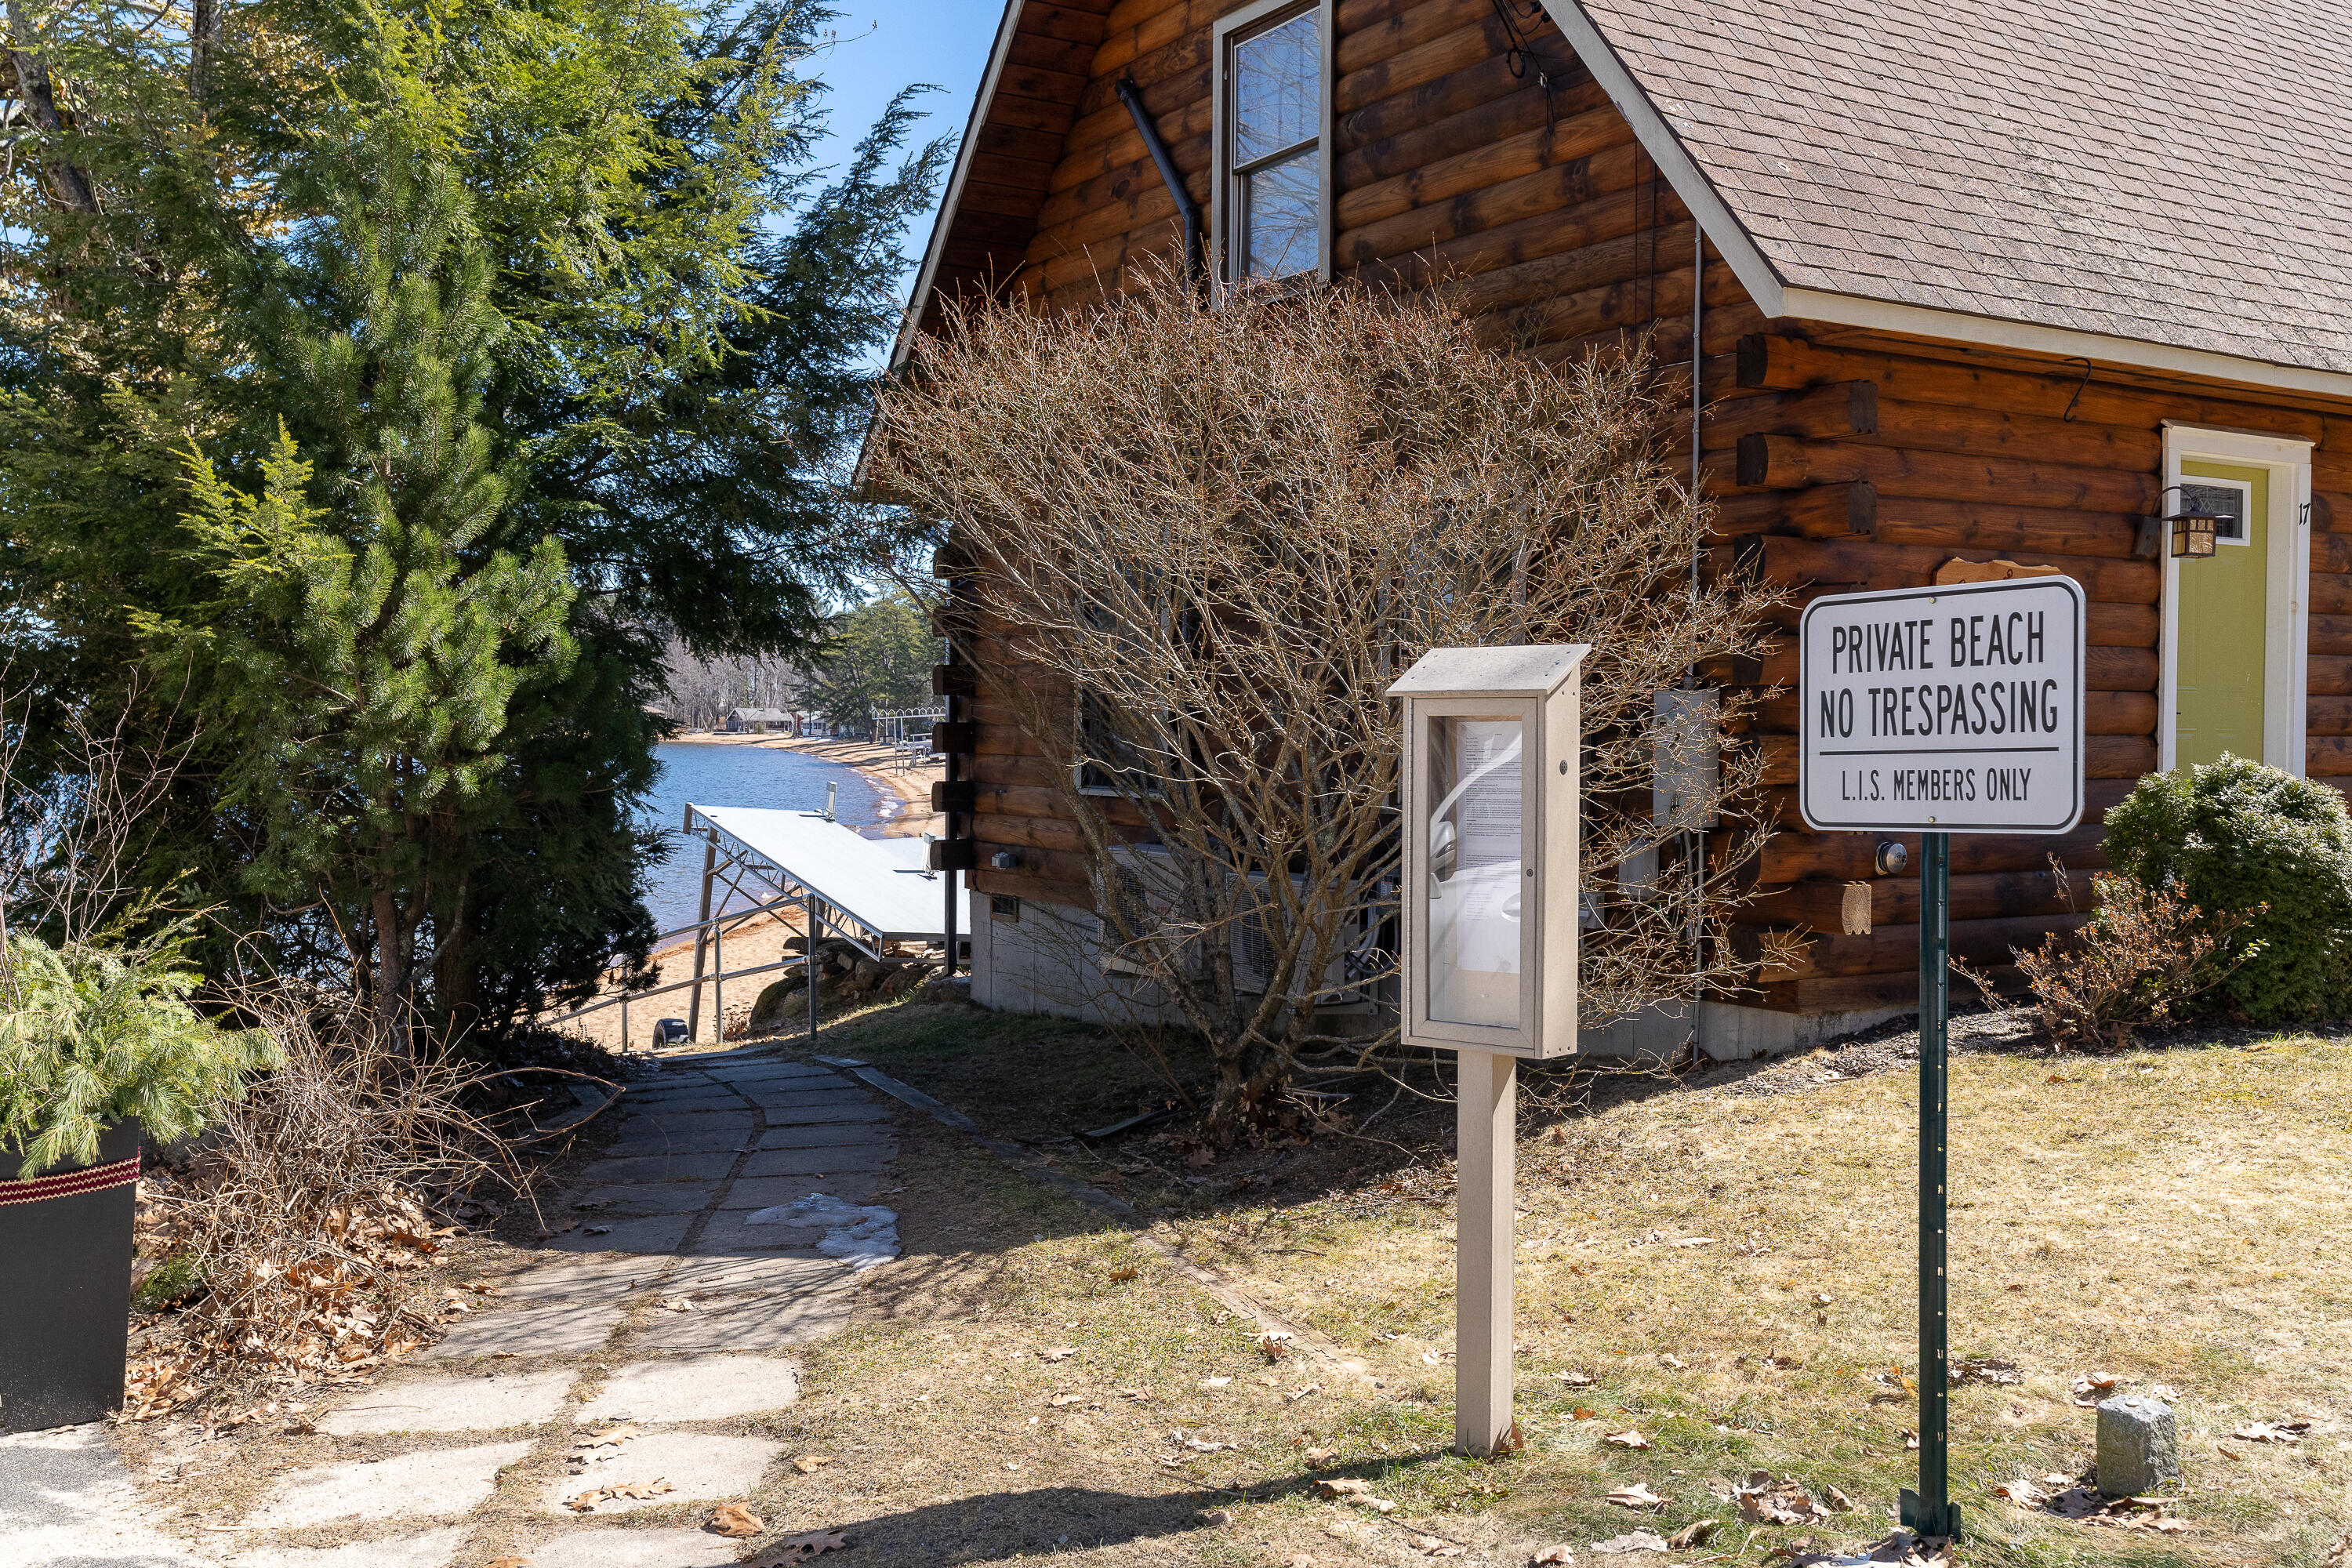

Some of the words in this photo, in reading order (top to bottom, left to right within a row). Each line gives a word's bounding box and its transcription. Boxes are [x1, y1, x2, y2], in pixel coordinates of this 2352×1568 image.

[2299, 503, 2310, 526] 17
[1831, 619, 1934, 674] PRIVATE
[1950, 611, 2045, 668] BEACH
[1820, 688, 1854, 739] NO
[1867, 678, 2059, 737] TRESPASSING
[1842, 769, 1886, 801] L.I.S.
[1893, 768, 1976, 802] MEMBERS
[1986, 768, 2032, 801] ONLY
